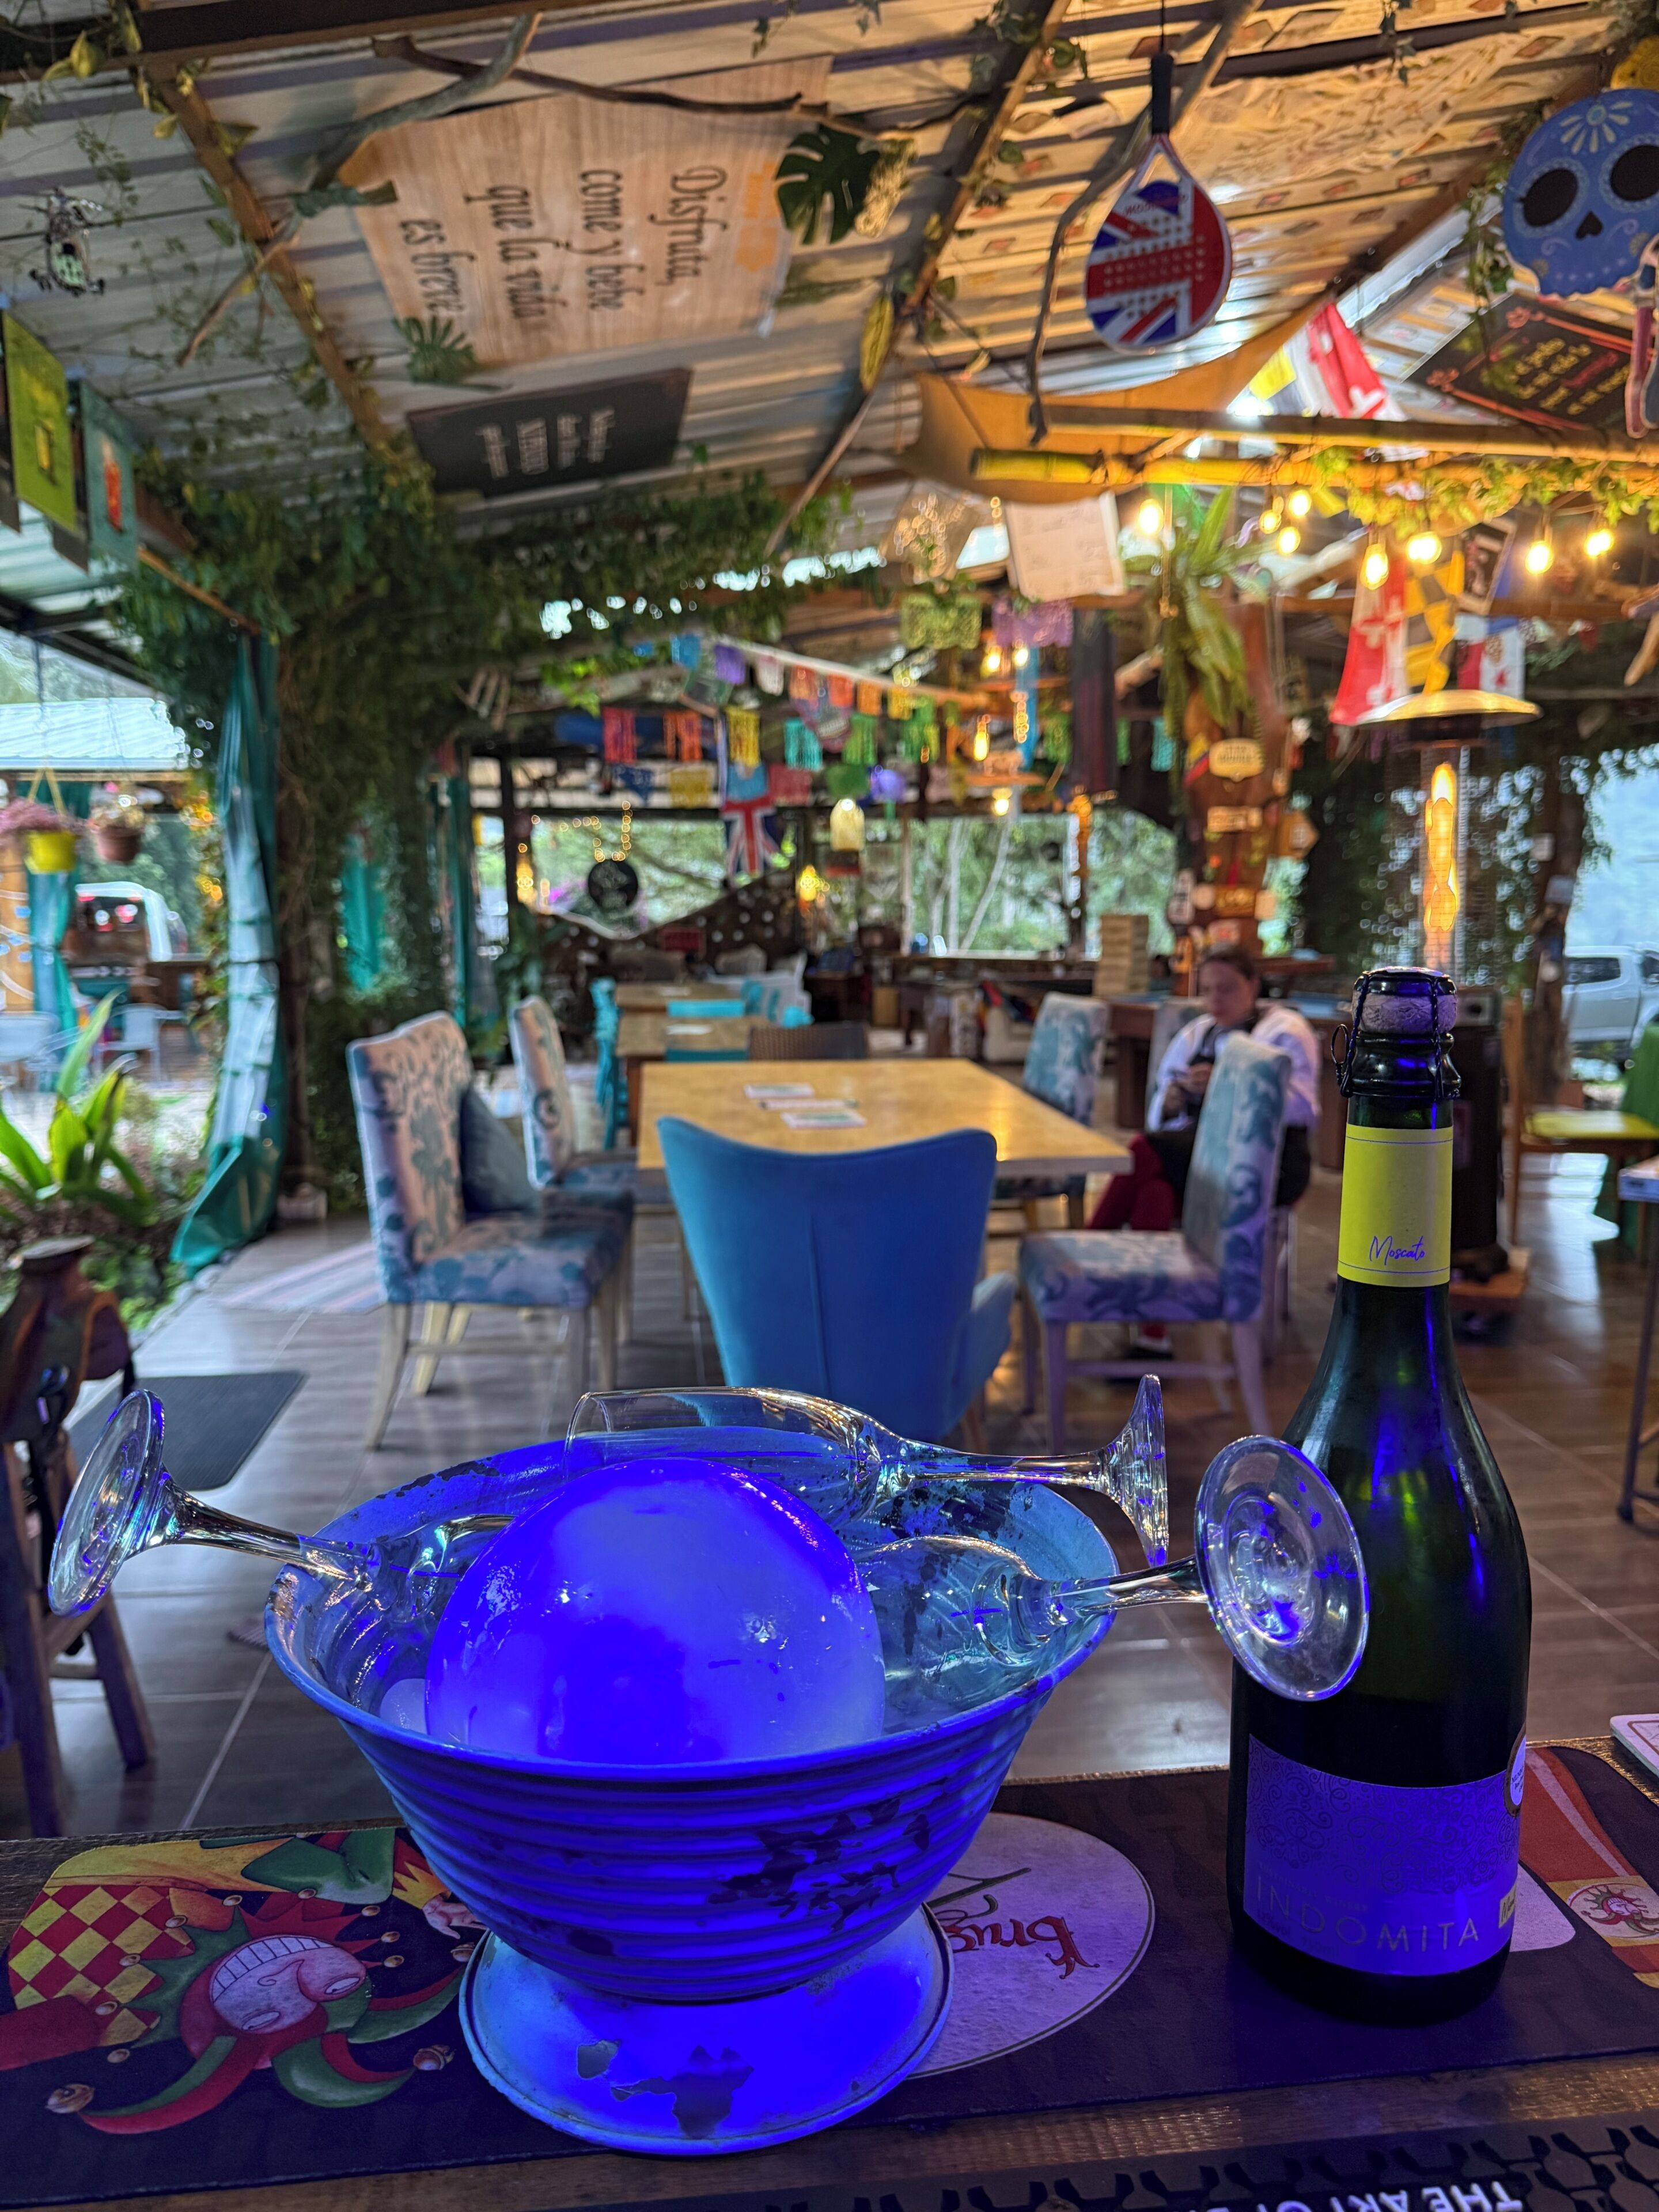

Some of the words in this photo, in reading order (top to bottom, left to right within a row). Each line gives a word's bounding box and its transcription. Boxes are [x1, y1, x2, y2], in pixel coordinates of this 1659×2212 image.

[465, 185, 532, 230] que
[579, 168, 623, 232] come
[400, 218, 445, 245] es
[564, 238, 623, 256] y
[649, 166, 728, 286] Disfruta,
[499, 237, 562, 263] la
[411, 251, 476, 314] breve
[502, 269, 568, 320] vida
[586, 264, 646, 312] bebe
[1369, 1235, 1426, 1266] Moscato
[1256, 1873, 1479, 1953] INDOMITA
[1421, 2180, 1524, 2212] THE
